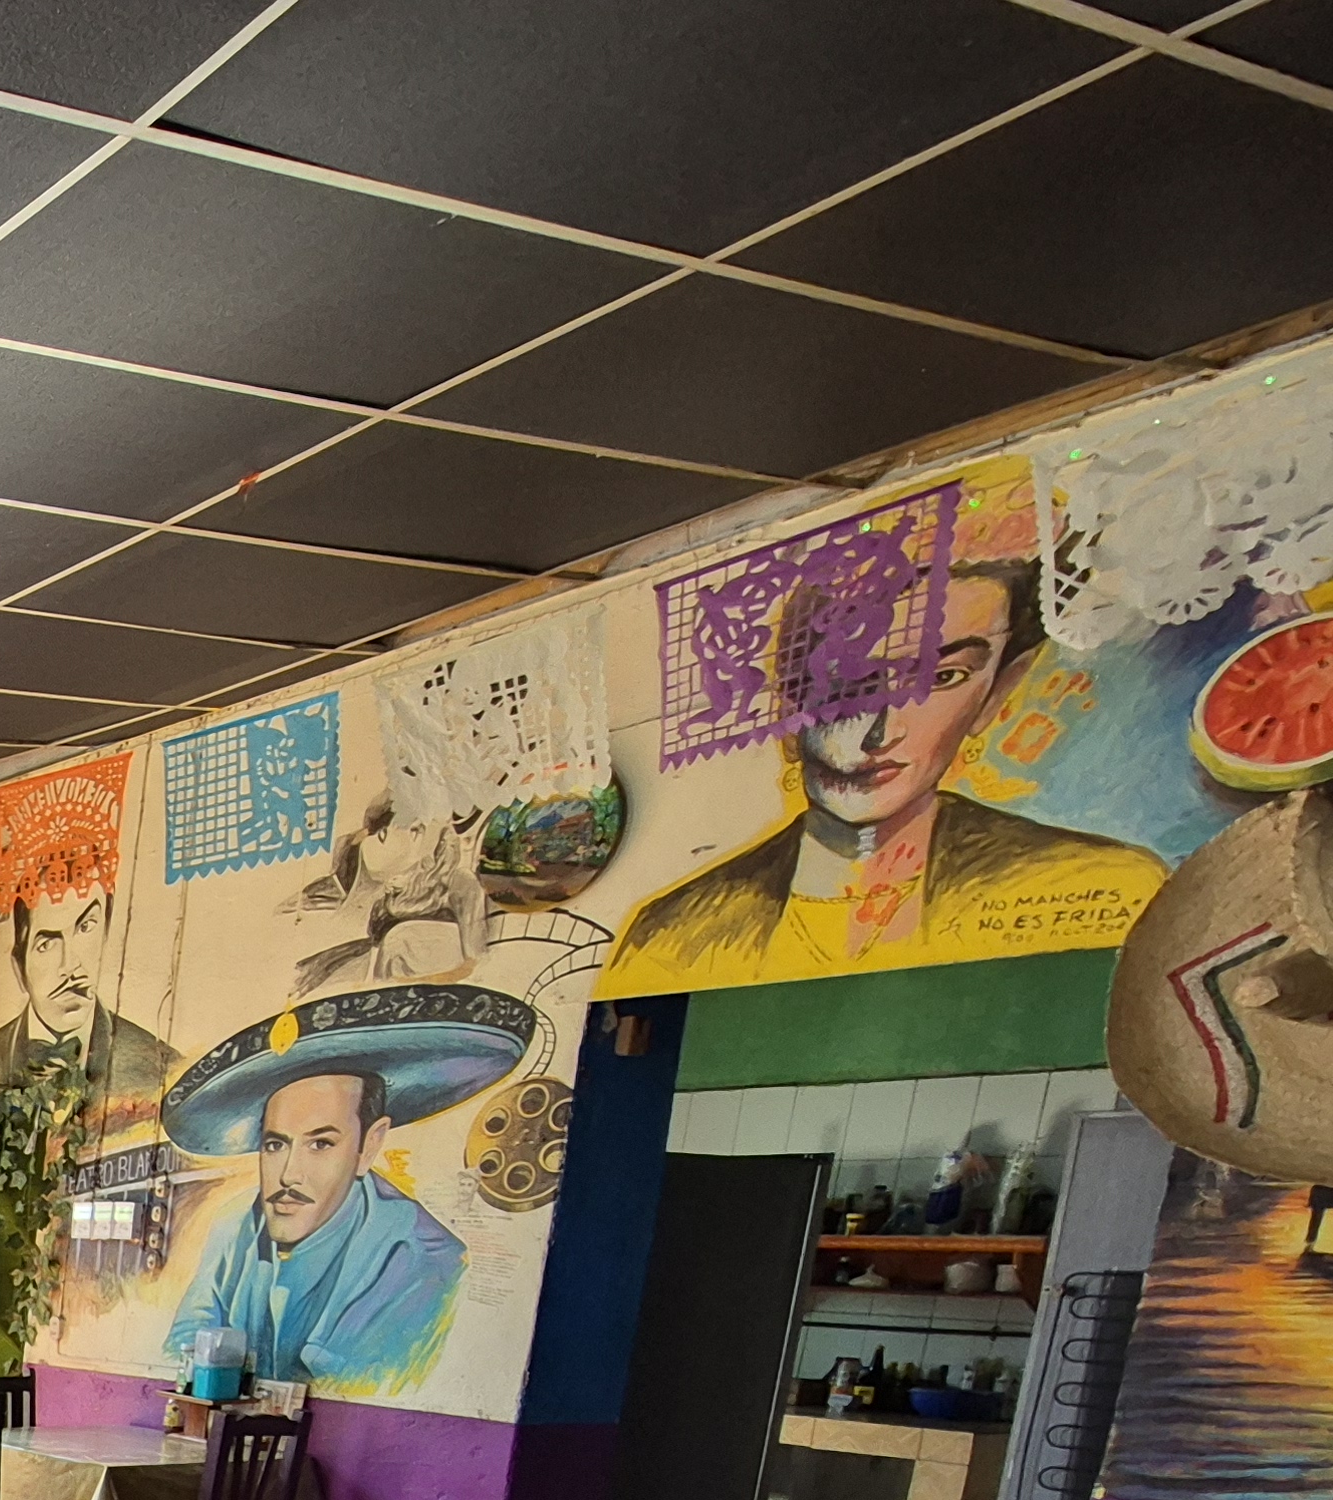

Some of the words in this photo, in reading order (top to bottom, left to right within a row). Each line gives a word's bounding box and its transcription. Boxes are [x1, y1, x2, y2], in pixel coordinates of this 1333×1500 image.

[981, 899, 1007, 913] NO
[1014, 887, 1121, 909] MANCHES
[977, 916, 1005, 932] NO
[1013, 913, 1043, 930] ES
[1052, 904, 1131, 926] FRIDA
[64, 1161, 114, 1194] EATRO
